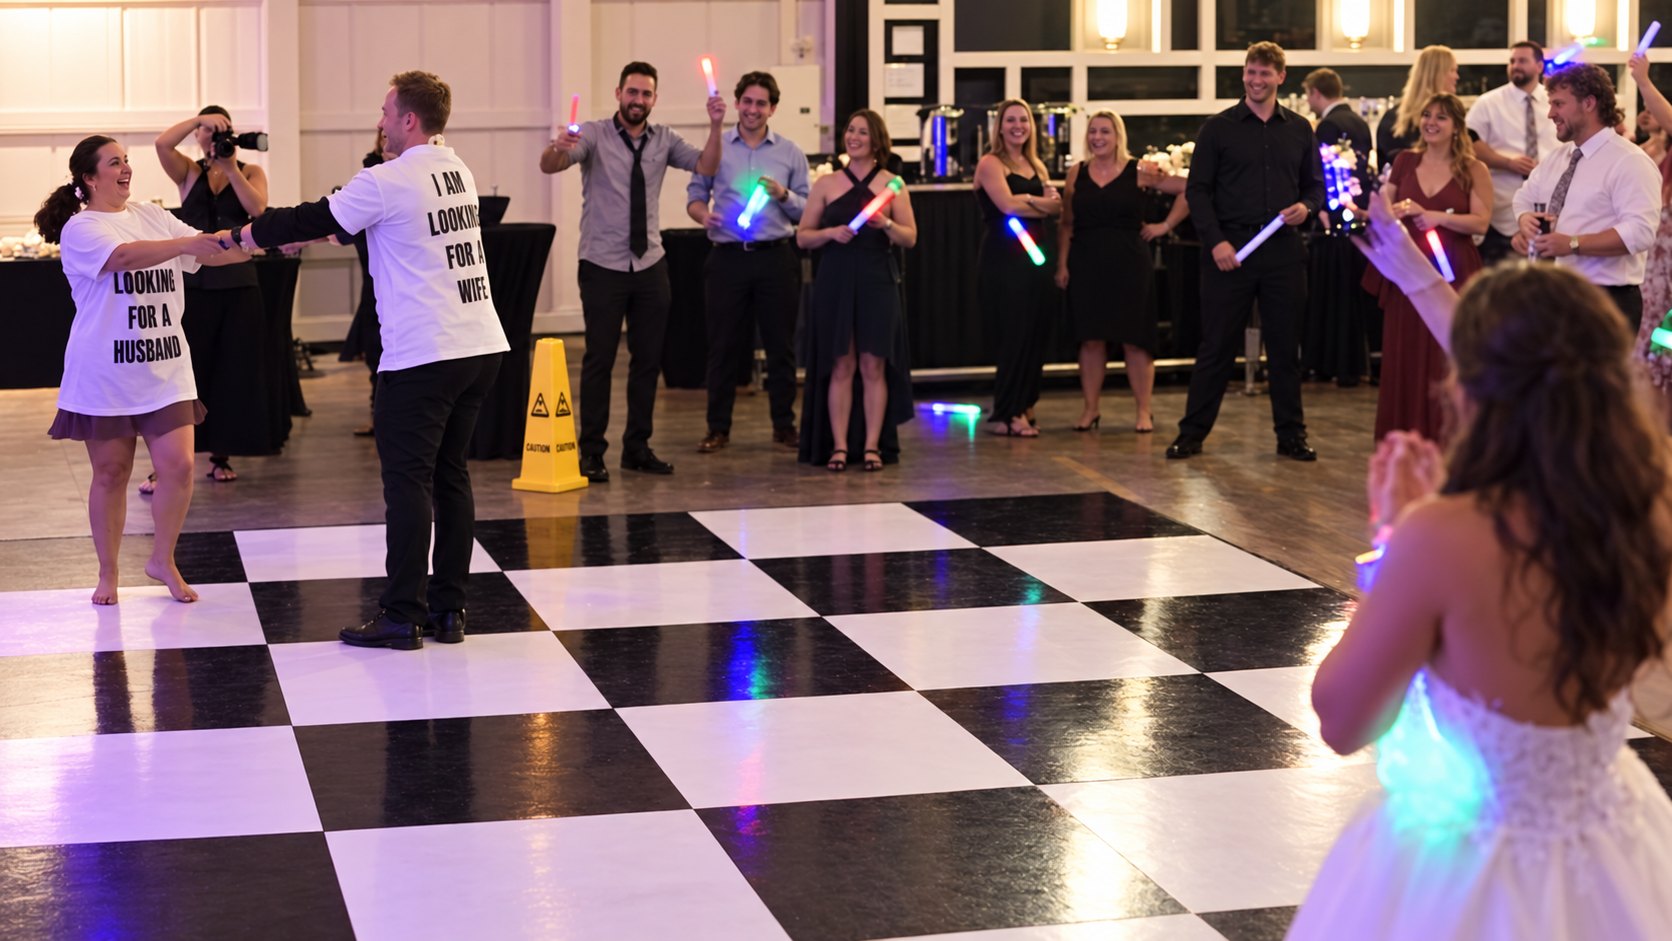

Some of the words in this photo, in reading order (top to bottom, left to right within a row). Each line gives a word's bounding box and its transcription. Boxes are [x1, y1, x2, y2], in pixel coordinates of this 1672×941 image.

[431, 173, 442, 197] I
[442, 171, 466, 195] AM
[445, 242, 476, 270] FOR
[477, 239, 485, 264] A
[113, 268, 176, 294] LOOKING
[457, 276, 489, 304] WIFE
[128, 305, 158, 329] FOR
[162, 303, 172, 327] A
[113, 335, 182, 363] HUSBAND
[526, 442, 551, 453] CAUTION
